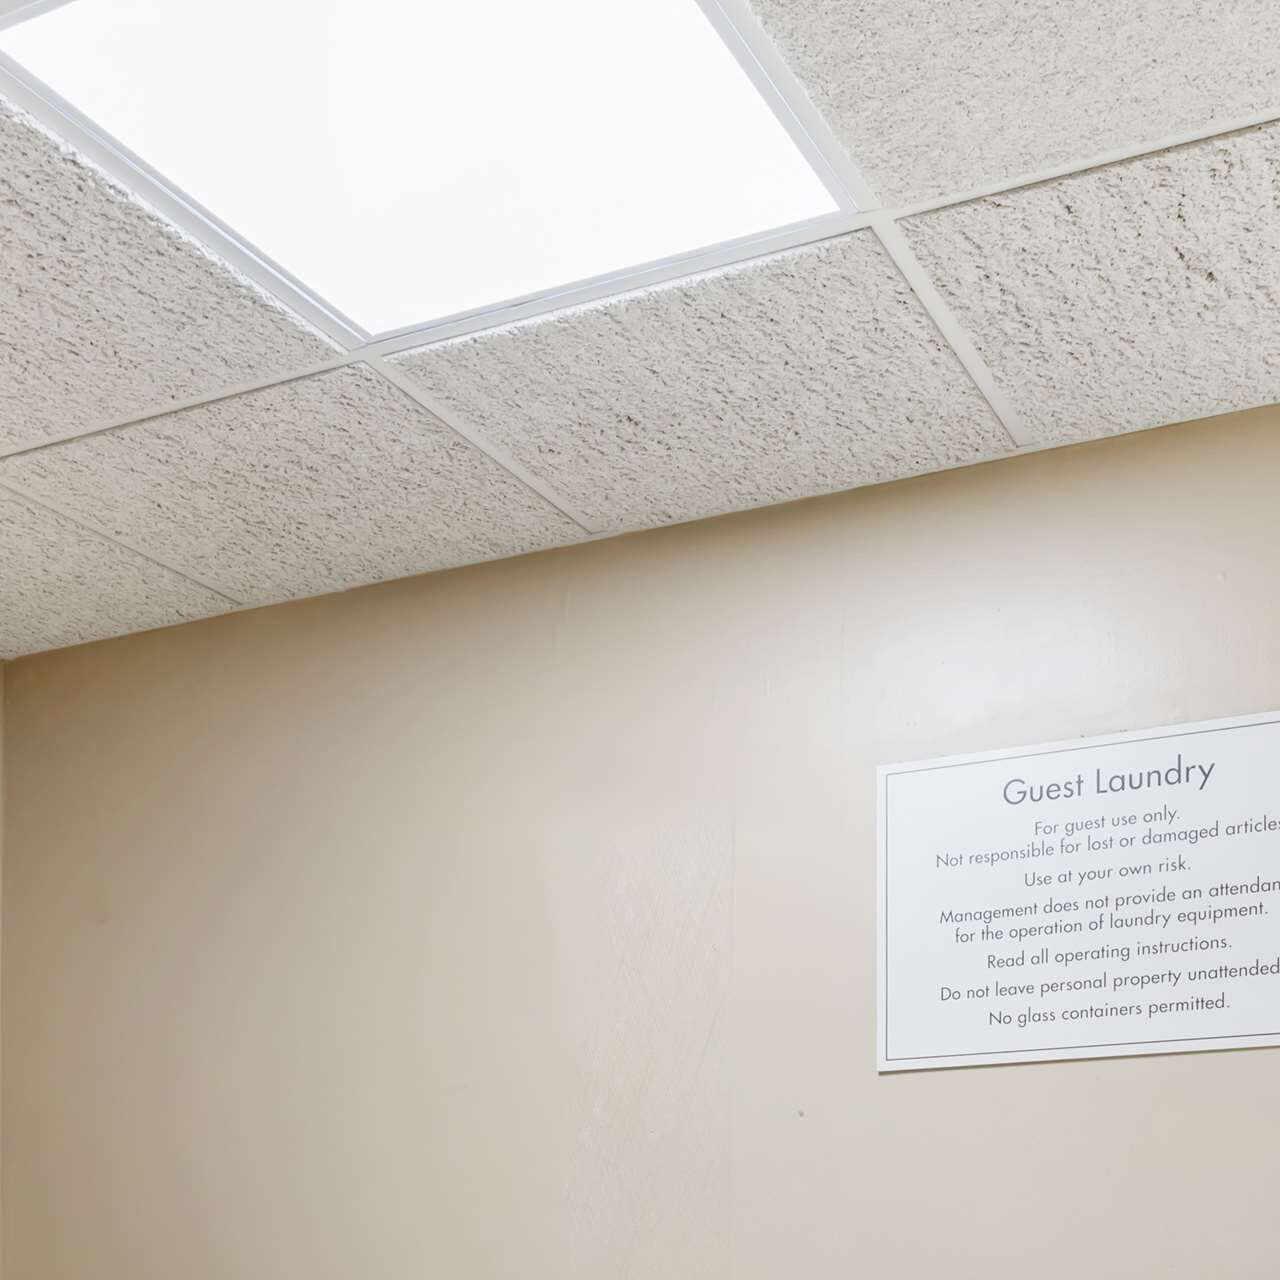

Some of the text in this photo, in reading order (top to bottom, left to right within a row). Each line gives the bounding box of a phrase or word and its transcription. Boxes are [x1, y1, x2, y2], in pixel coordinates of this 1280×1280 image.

[1003, 754, 1215, 805] Guest Laundry
[1034, 804, 1181, 837] For guest use only.
[936, 853, 963, 868] Not
[969, 840, 1054, 867] responsible
[1060, 838, 1082, 855] for
[1087, 835, 1114, 852] lost
[1119, 835, 1136, 848] or
[1142, 820, 1219, 845] damaged
[1024, 854, 1191, 887] Use at your own risk.
[940, 903, 1038, 924] Management
[1043, 896, 1079, 914] does
[1085, 896, 1109, 910] not
[1115, 886, 1176, 911] provide
[1182, 888, 1203, 901] an
[955, 902, 1268, 944] for the operation of laundry equipment.
[987, 935, 1232, 969] Read all operating instructions.
[940, 986, 961, 1001] Do
[967, 984, 990, 1000] not
[995, 981, 1035, 997] leave
[1040, 971, 1107, 998] personal
[1113, 970, 1181, 992] property
[989, 992, 1230, 1028] No glass containers permitted.
